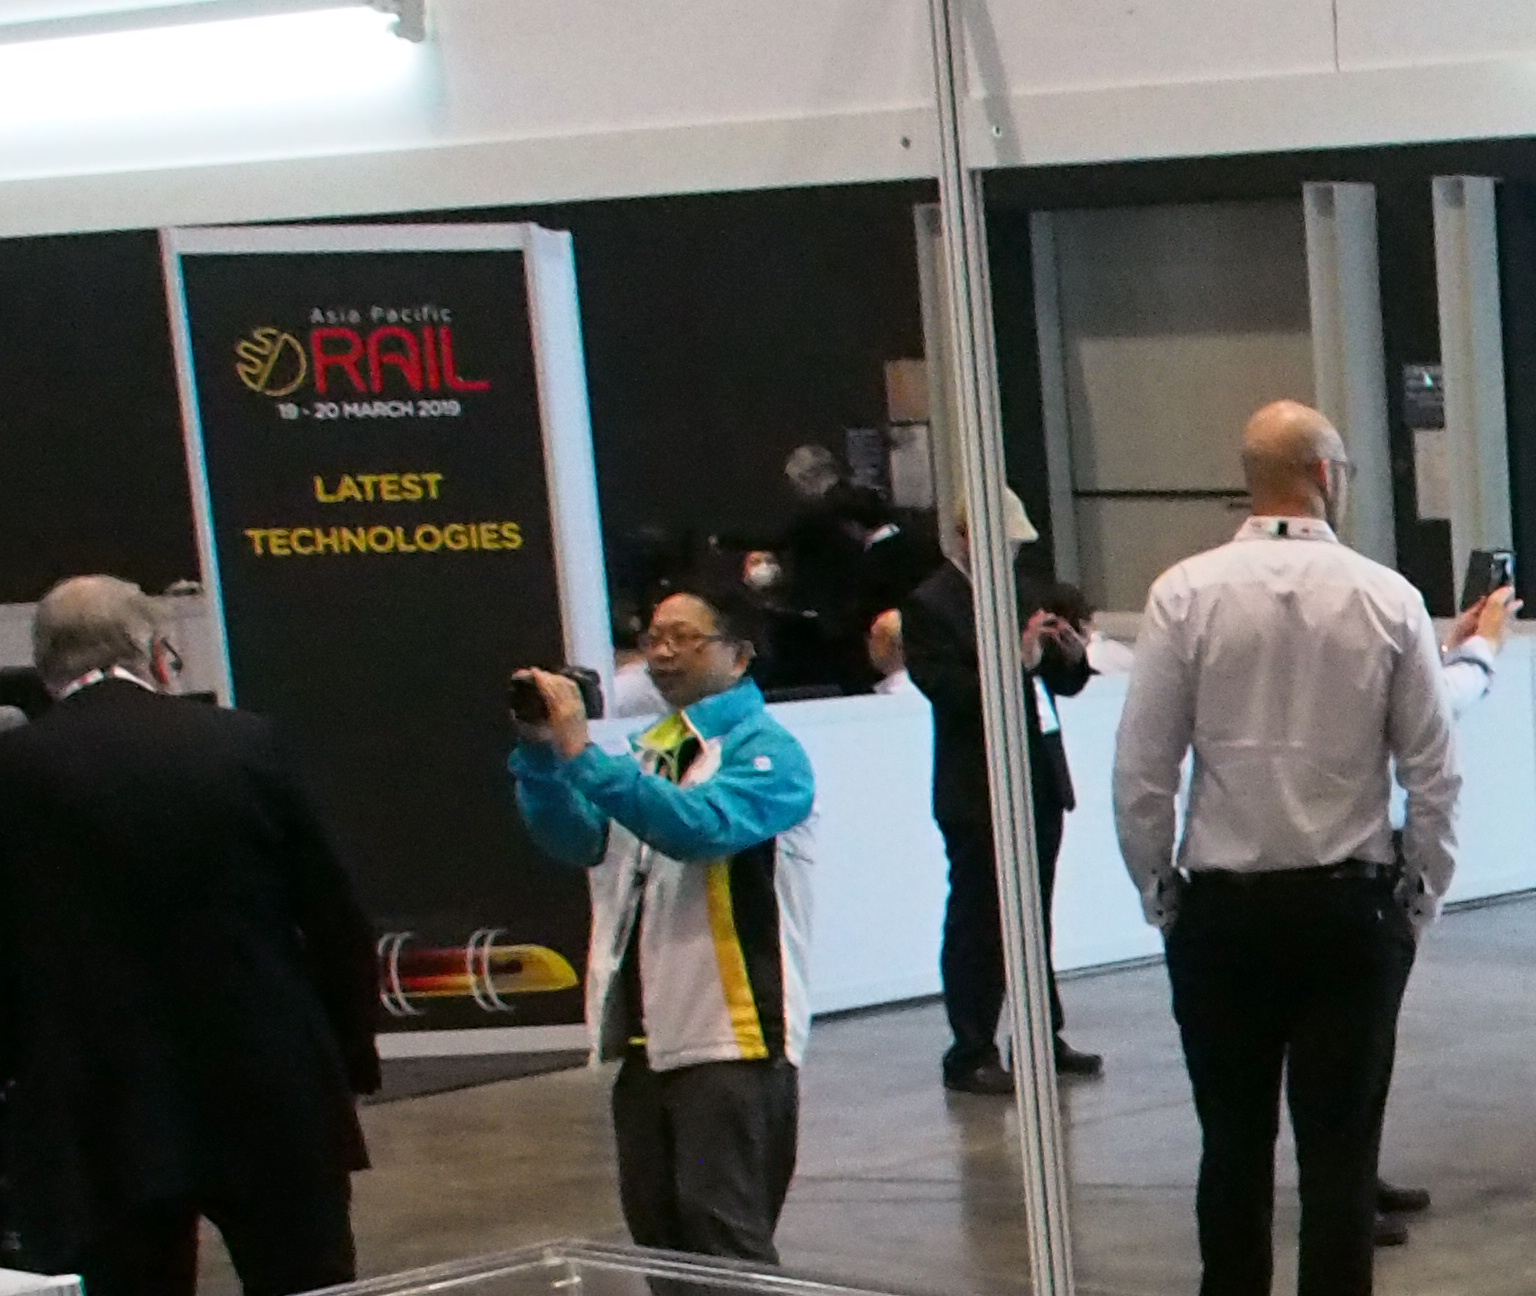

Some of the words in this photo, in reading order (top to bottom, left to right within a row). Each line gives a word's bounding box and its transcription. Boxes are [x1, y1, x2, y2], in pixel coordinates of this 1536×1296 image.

[310, 306, 362, 325] Asia
[370, 304, 453, 324] Pacific
[310, 325, 492, 394] RAIL
[313, 401, 340, 420] 20
[342, 400, 415, 420] MARCH
[417, 399, 463, 418] 2019
[313, 472, 443, 503] LATEST
[245, 522, 524, 557] TECHNOLOGIES
